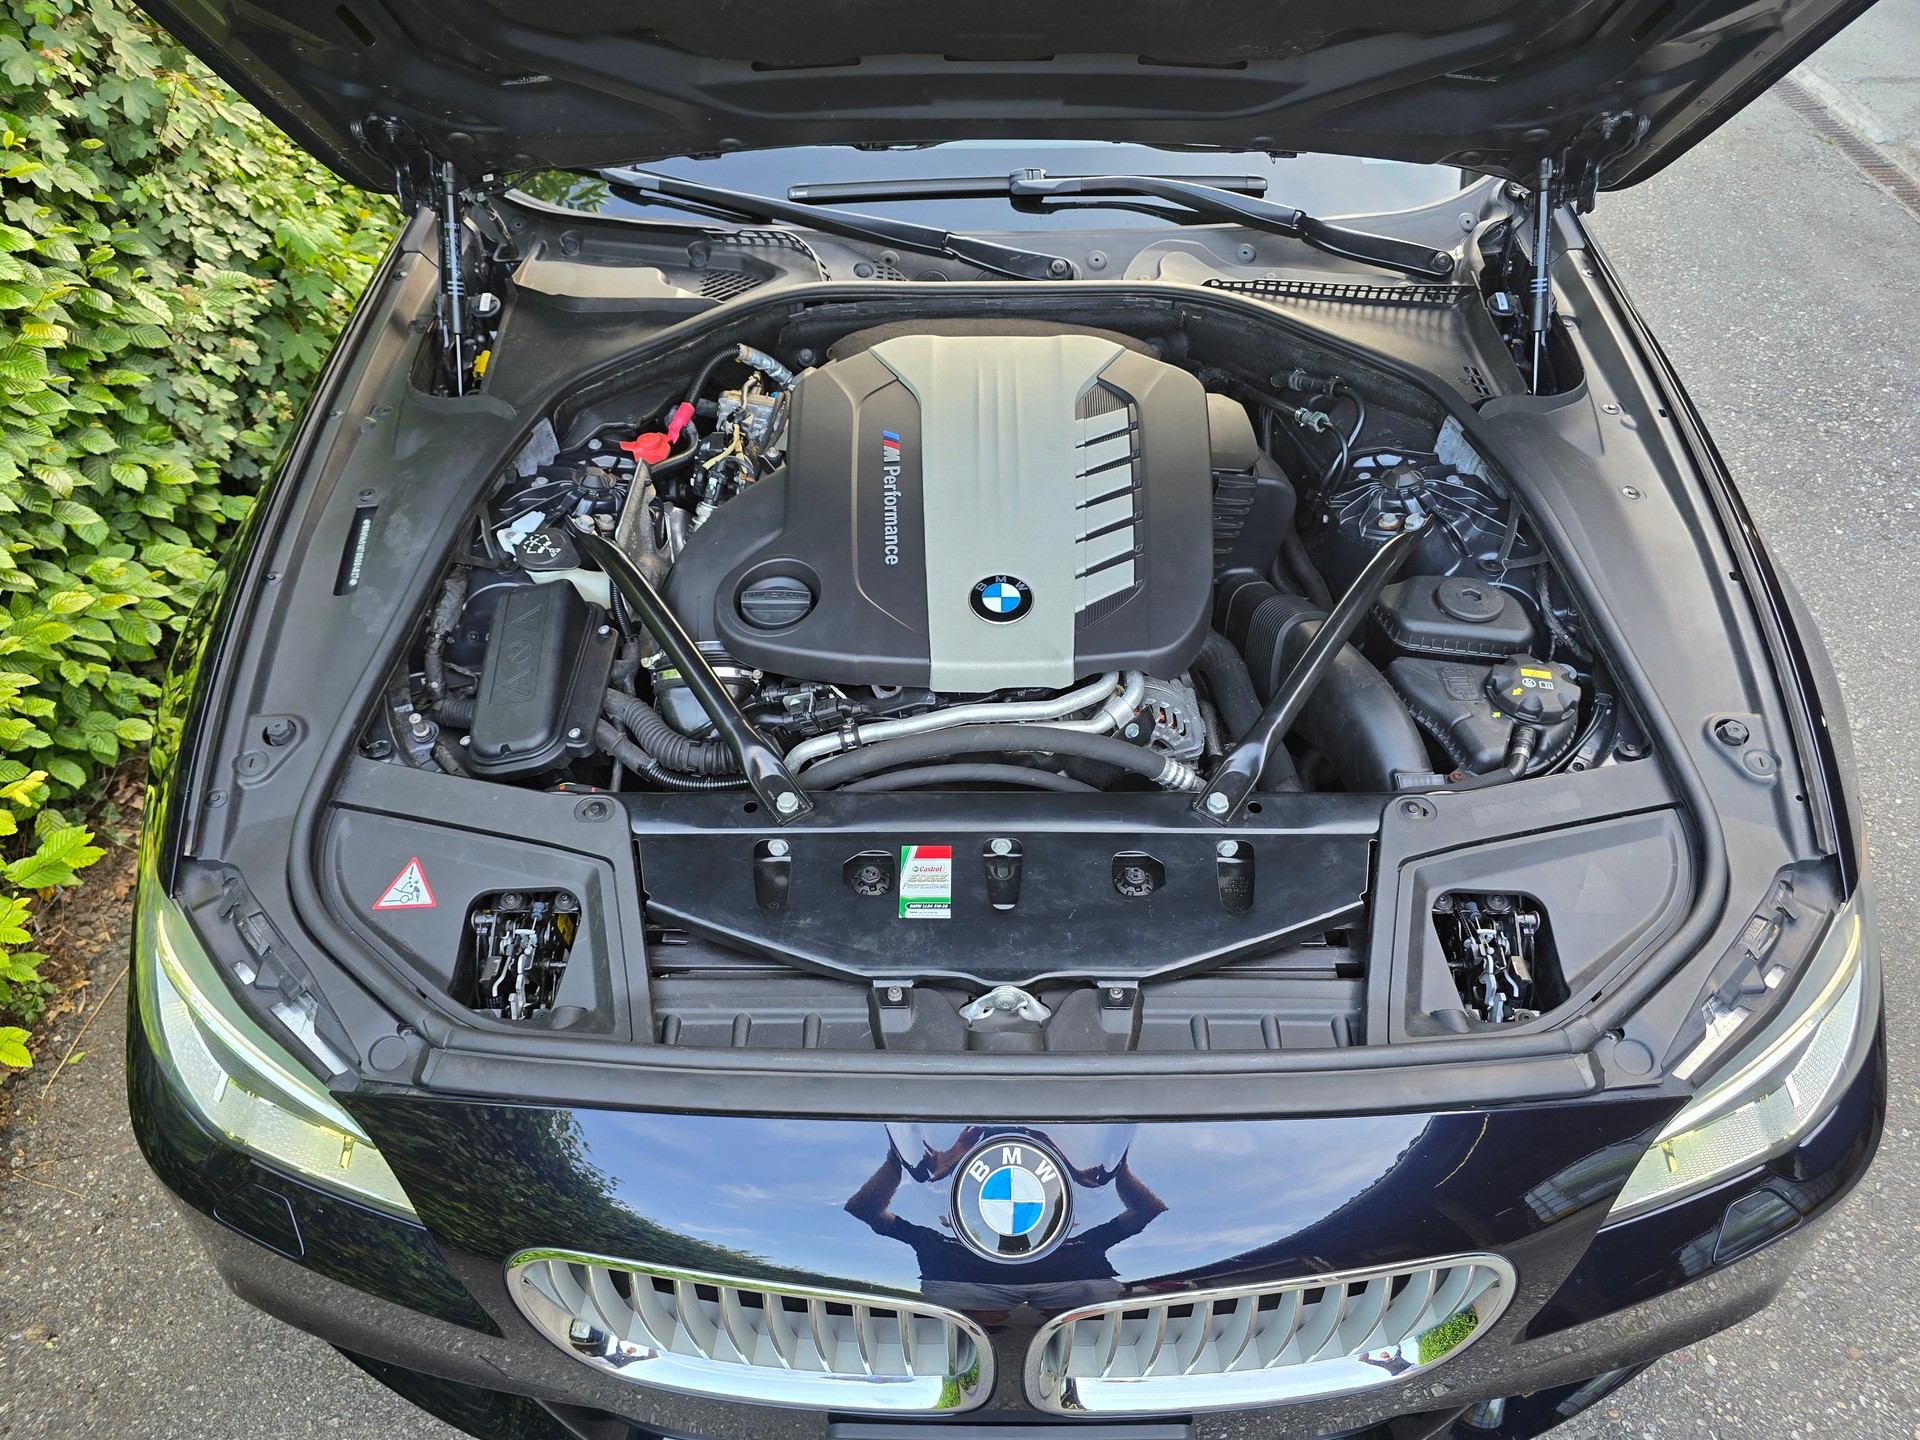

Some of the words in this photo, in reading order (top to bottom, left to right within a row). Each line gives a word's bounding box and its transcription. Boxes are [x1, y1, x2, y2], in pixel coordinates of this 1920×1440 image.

[883, 465, 901, 566] Performance
[975, 575, 1028, 592] BMW
[908, 873, 949, 882] EDGE
[968, 1146, 1057, 1183] BMW
